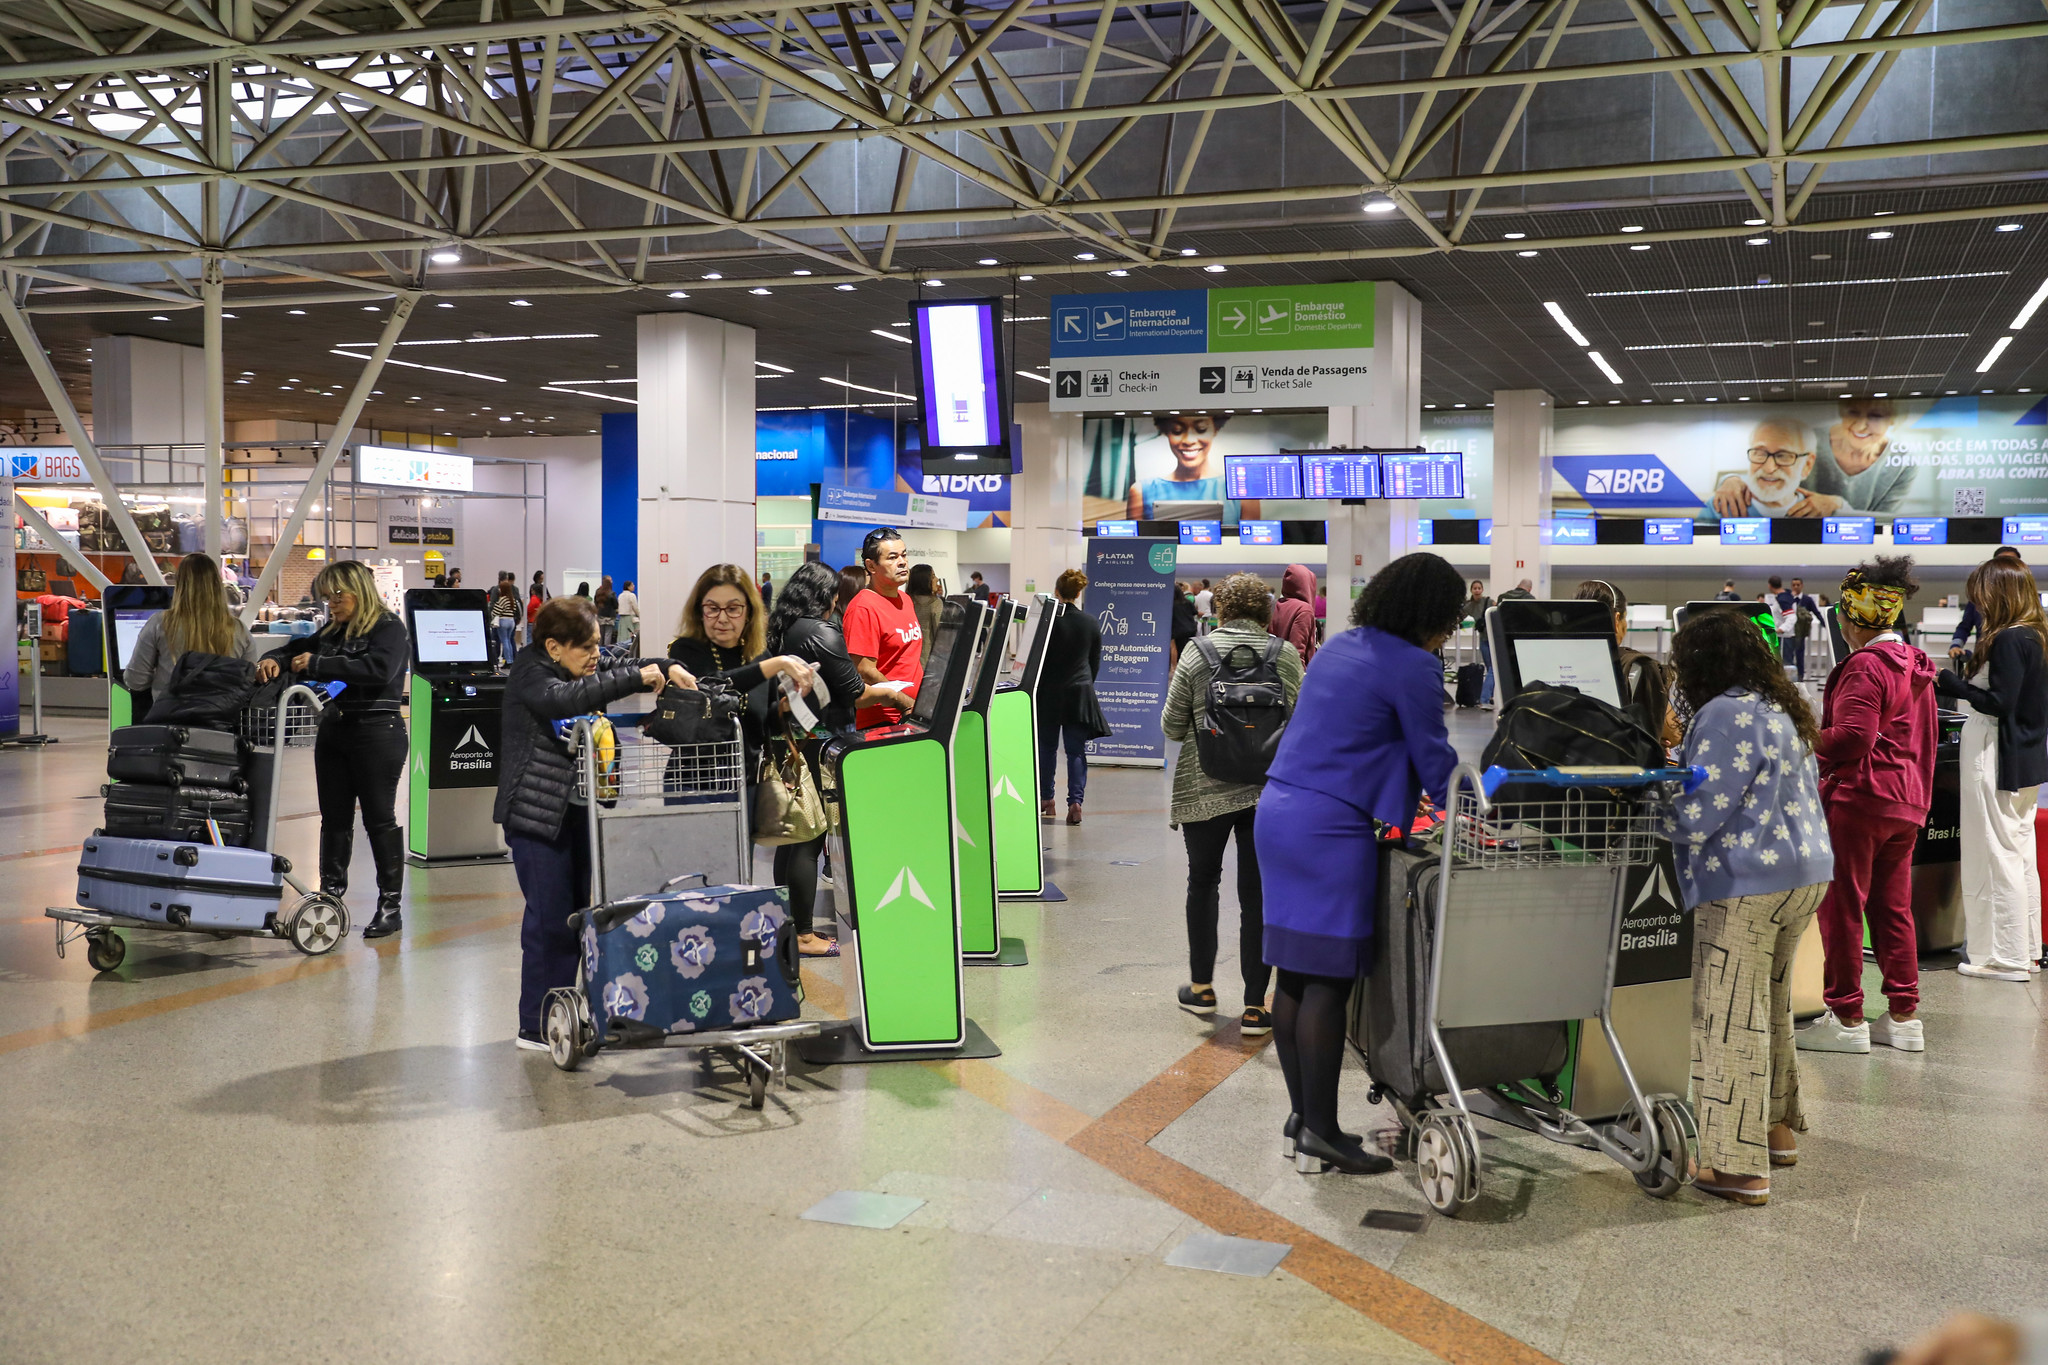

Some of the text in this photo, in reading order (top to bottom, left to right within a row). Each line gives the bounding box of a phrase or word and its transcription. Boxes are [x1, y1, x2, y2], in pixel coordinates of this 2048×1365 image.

[1295, 302, 1344, 312] Embarque
[1129, 309, 1176, 318] Embarque
[1295, 310, 1346, 321] Doméstico
[1129, 317, 1190, 327] Internacional
[1294, 323, 1326, 331] Domestic
[1129, 328, 1203, 337] International Departure
[1119, 371, 1160, 380] Check-in
[1261, 366, 1367, 376] Venda de Passagens
[1119, 383, 1158, 393] Check-in
[1261, 379, 1313, 389] Ticket Sale
[1890, 441, 1922, 453] COM
[1927, 438, 1963, 452] VOCÊ
[1966, 440, 1987, 451] EM
[1991, 438, 2038, 451] TODAS
[1885, 454, 1962, 467] JORNADAS.
[1965, 454, 1995, 466] BOA
[45, 456, 80, 477] BAGS
[1937, 468, 1975, 480] ABRA
[1978, 468, 2005, 479] SUA
[950, 475, 1002, 493] BRB
[1613, 468, 1665, 493] BRB
[389, 515, 428, 523] EXPERIMETE
[1147, 582, 1166, 590] serviço
[1119, 644, 1162, 653] Automática
[1114, 654, 1149, 664] Bagagem
[1130, 667, 1142, 675] Drop
[450, 759, 492, 769] Brasília
[1621, 913, 1681, 929] Aeroporto de
[1620, 929, 1678, 950] Brasília
